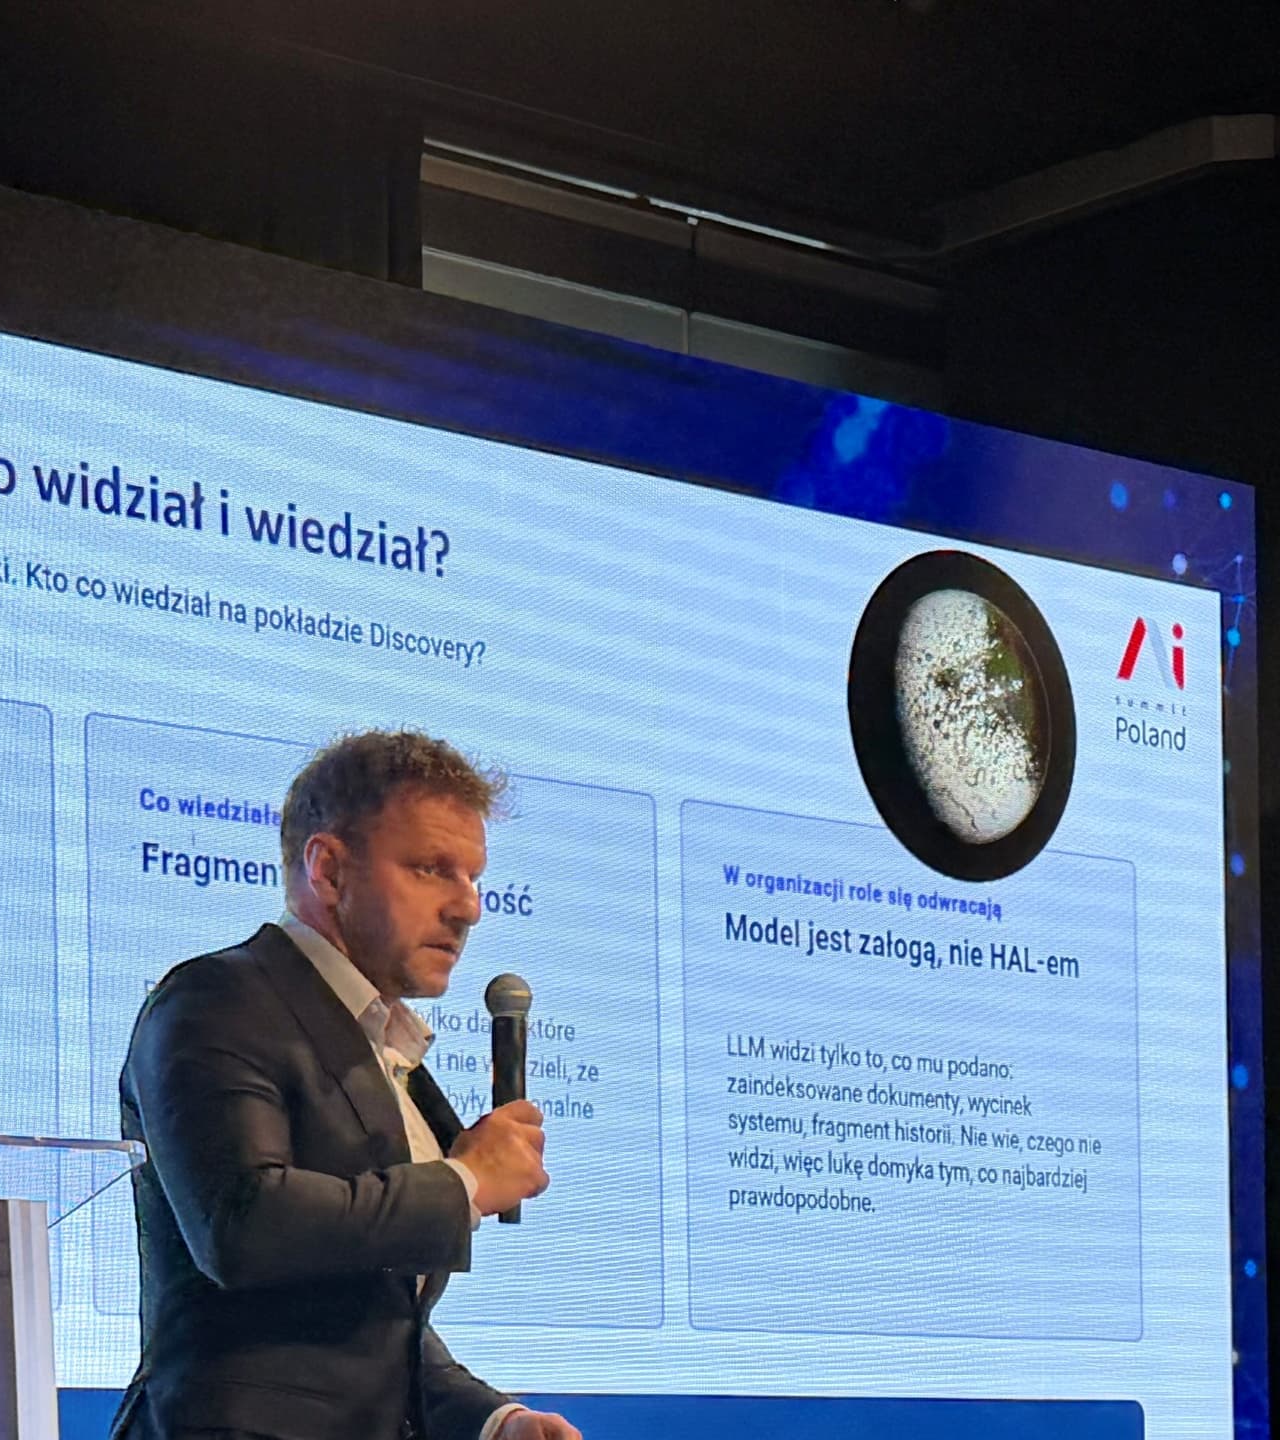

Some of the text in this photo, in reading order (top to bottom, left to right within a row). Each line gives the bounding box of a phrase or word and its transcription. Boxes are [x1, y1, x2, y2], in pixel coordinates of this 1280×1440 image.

[34, 461, 204, 530] widział
[220, 489, 229, 535] i
[246, 503, 450, 577] wiedział?
[26, 562, 68, 593] Kto
[76, 575, 106, 599] co
[113, 579, 211, 620] wiedział
[219, 600, 247, 624] na
[255, 603, 363, 645] pokładzie
[371, 621, 487, 668] Discovery?
[1116, 717, 1186, 751] Poland
[139, 787, 170, 812] Co
[142, 842, 282, 887] Fragmen
[722, 863, 1003, 921] W organizacji role się odwracają
[725, 912, 1080, 979] Model jest załogą, nie HAL-em
[448, 1050, 477, 1072] nie
[578, 1062, 599, 1082] że
[726, 1035, 1014, 1081] LLM widzi tylko to, co mu podano:
[727, 1074, 1032, 1118] zaindeksowane dokumenty, wycinek
[728, 1112, 808, 1140] systemu,
[811, 1117, 891, 1144] fragment
[894, 1122, 955, 1147] historii.
[961, 1125, 988, 1147] Nie
[1026, 1134, 1074, 1158] czego
[1078, 1136, 1101, 1155] nie
[728, 1147, 1088, 1193] widzi, więc lukę domyka tym, co najbardziej
[728, 1185, 876, 1215] prawdopodobne.
